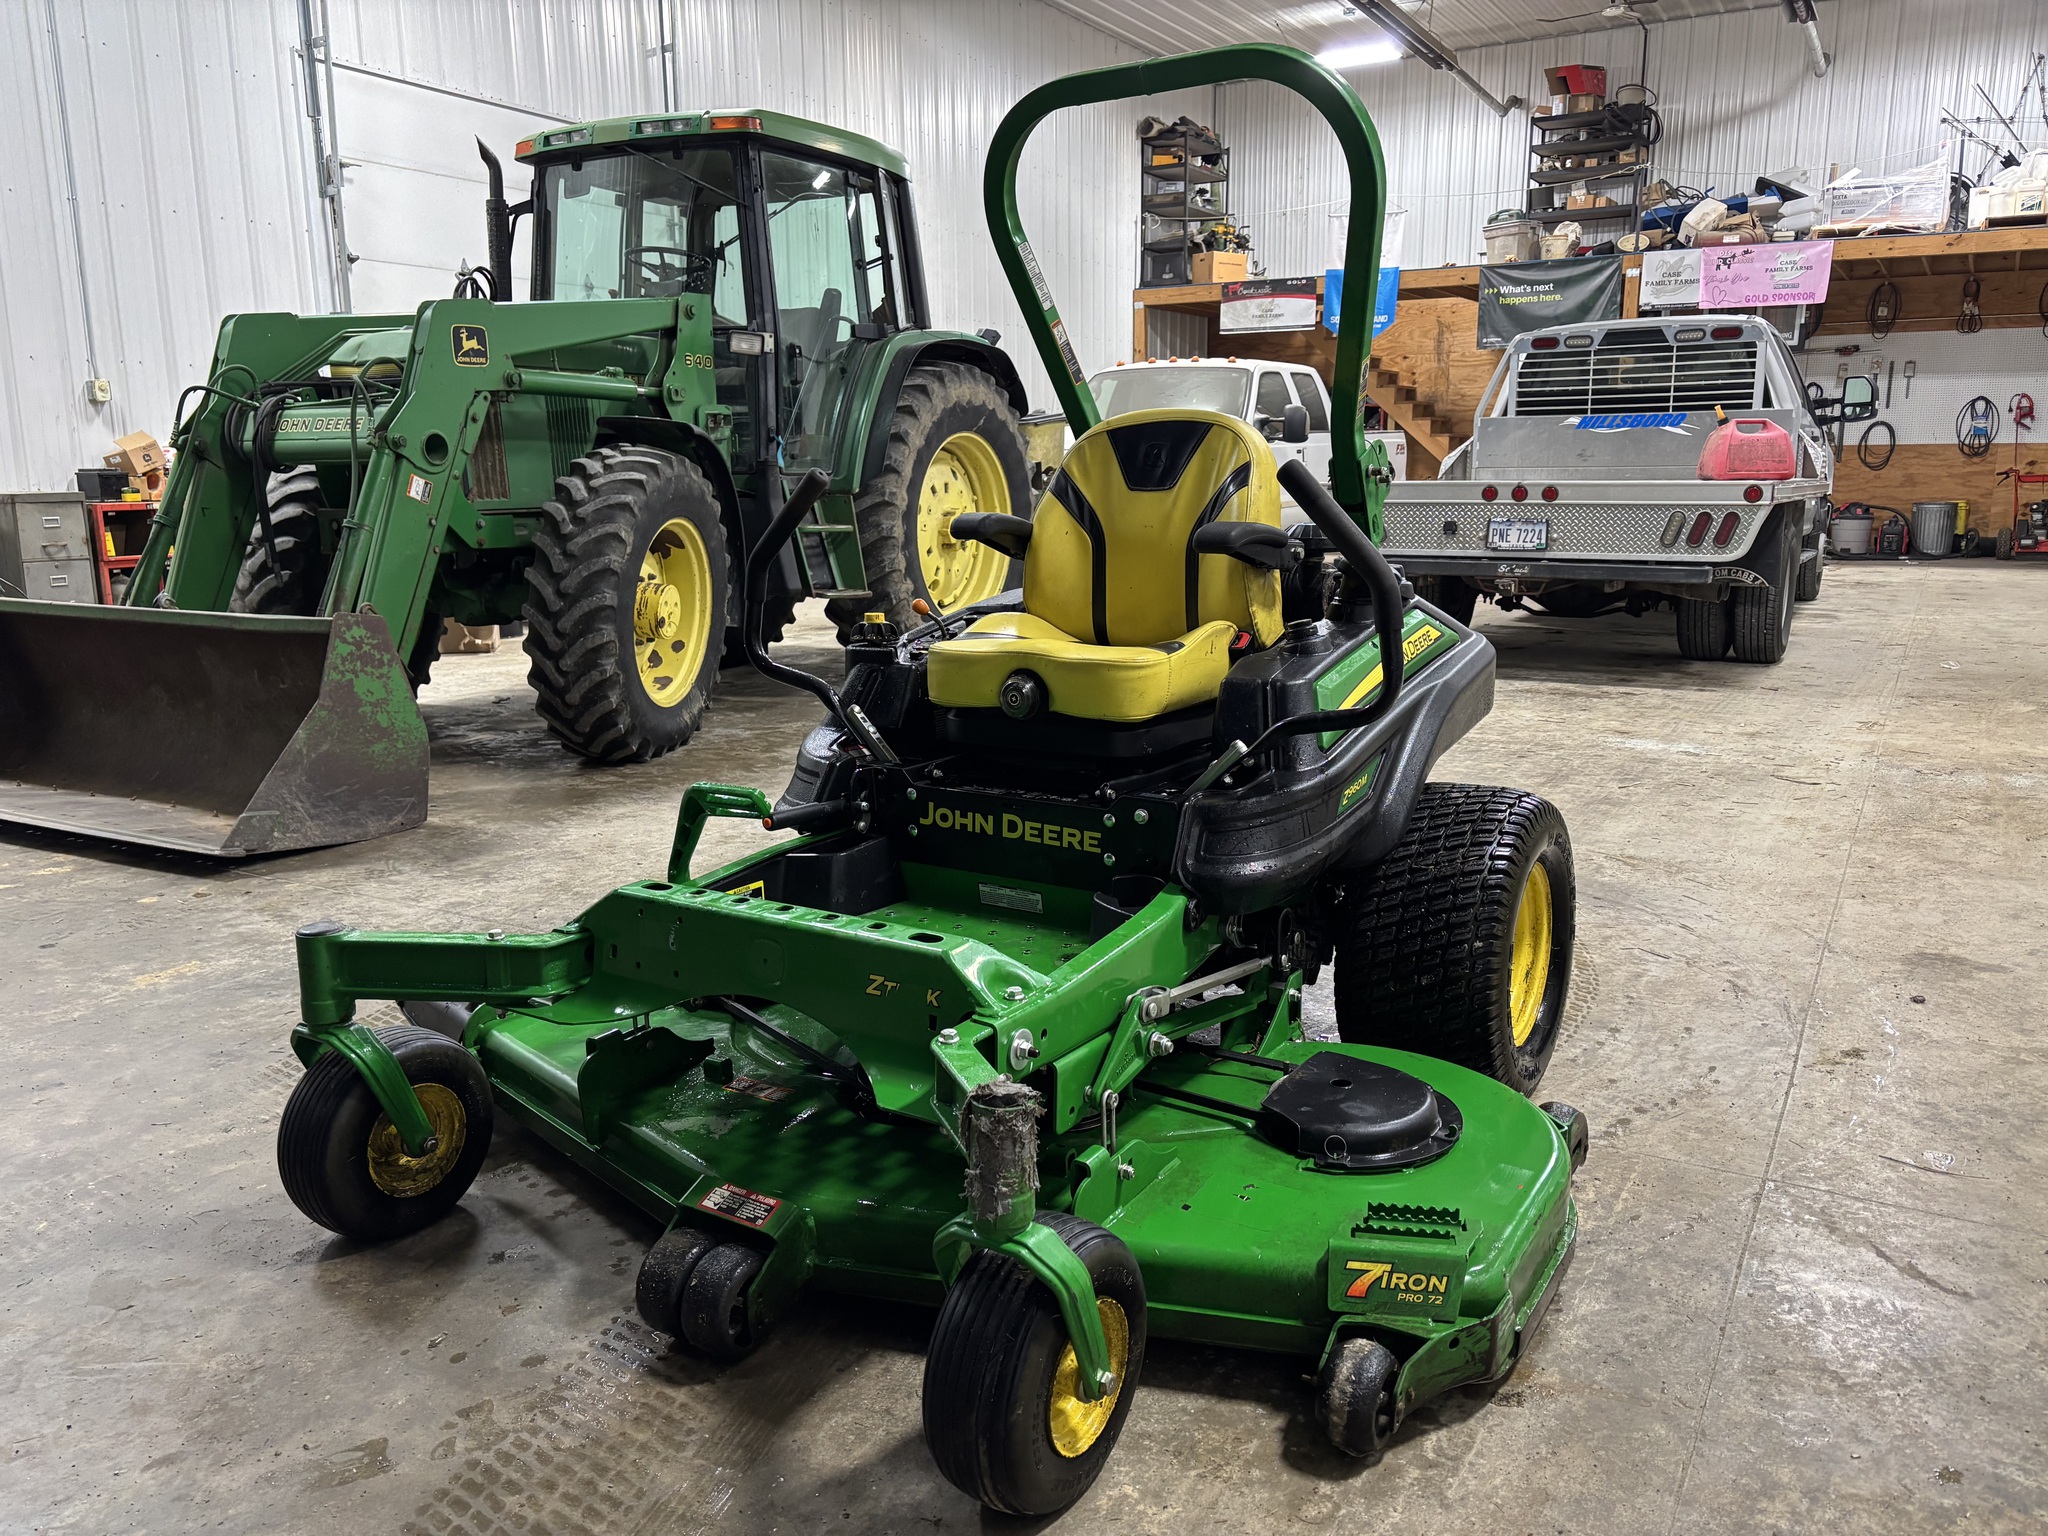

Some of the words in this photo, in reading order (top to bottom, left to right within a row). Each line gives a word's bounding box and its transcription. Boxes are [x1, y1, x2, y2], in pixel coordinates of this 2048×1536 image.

[1533, 283, 1554, 292] next
[1499, 296, 1538, 305] happens
[1539, 294, 1563, 302] here.
[1745, 294, 1768, 303] GOLD
[684, 353, 713, 369] 640
[1575, 413, 1687, 430] HILLSBORO
[1491, 528, 1512, 543] PNE
[1516, 528, 1543, 543] 7224
[1730, 569, 1755, 582] CABS
[1407, 630, 1433, 656] DEERE
[1343, 773, 1368, 806] Z960M
[919, 801, 994, 836] JOHN
[1002, 813, 1102, 854] DEERE
[728, 1185, 748, 1195] DANGER
[756, 1195, 777, 1205] PELIGRO
[1345, 1260, 1393, 1298] 7
[1380, 1271, 1449, 1294] IRON
[1397, 1293, 1424, 1303] PRO
[1427, 1295, 1444, 1305] 72
